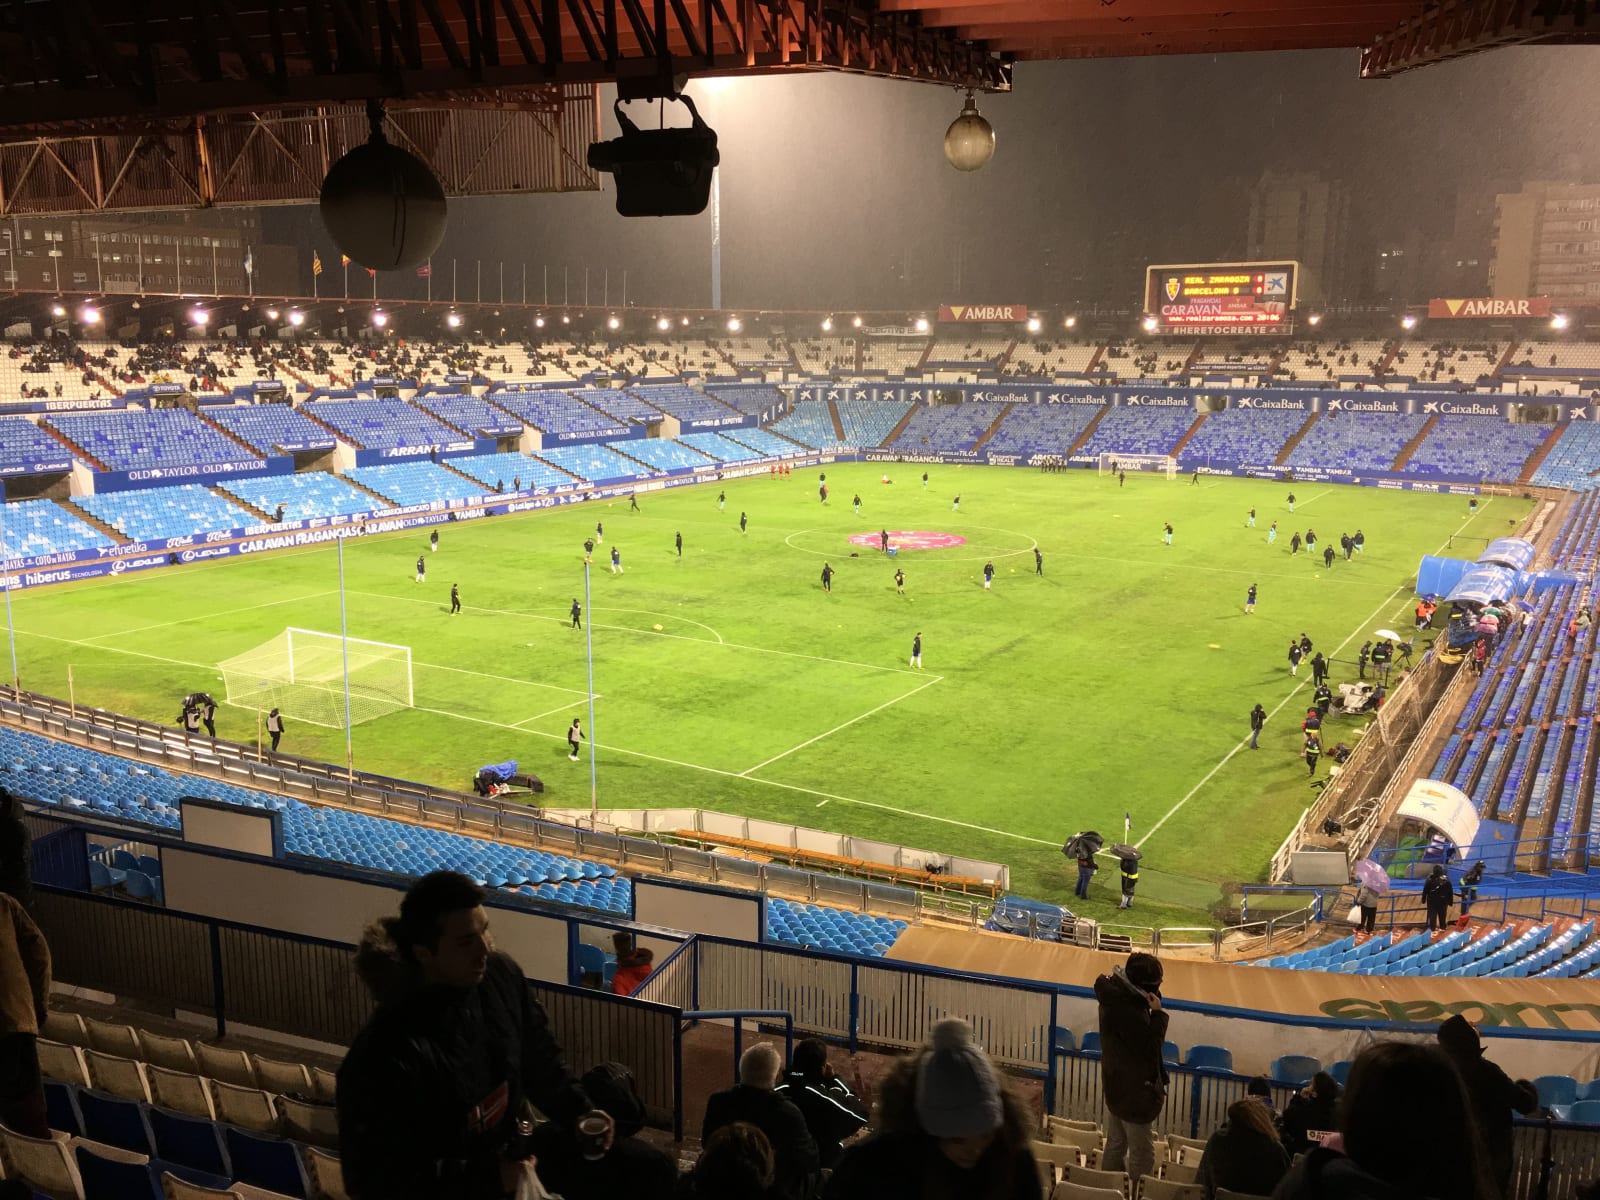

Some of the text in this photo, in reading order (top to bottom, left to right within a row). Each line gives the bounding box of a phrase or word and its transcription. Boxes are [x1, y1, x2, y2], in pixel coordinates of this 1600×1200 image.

[965, 307, 1014, 319] AMBAR
[1162, 305, 1221, 315] CARAVAN
[1463, 300, 1531, 315] AMBAR
[1173, 326, 1266, 334] #HERETOCREATE
[986, 392, 1028, 403] CaixaBank
[1061, 394, 1106, 405] CaixaBank
[1141, 396, 1189, 406] CaixaBank
[1253, 398, 1305, 409] CaixaBank
[45, 400, 112, 410] IBERPUERTAS
[1344, 400, 1399, 412] CaixaBank
[1440, 402, 1499, 415] CaixaBank
[866, 454, 899, 462] CARAVAN
[129, 460, 267, 480] OLD TAYLOR OLD TAYLOR
[460, 508, 485, 519] AMBAR
[404, 513, 449, 527] OLD TAYLOR
[245, 521, 302, 536] IBERPUERTAS
[239, 535, 294, 553] CARAVAN
[296, 527, 356, 545] FRAGANCIAS
[357, 520, 404, 536] CARAVAN
[109, 542, 147, 556] efinetika
[195, 547, 230, 557] LEXUS
[35, 555, 52, 566] COTO
[57, 551, 76, 562] HAYAS
[127, 556, 164, 568] LEXUS
[26, 570, 71, 585] hiberus
